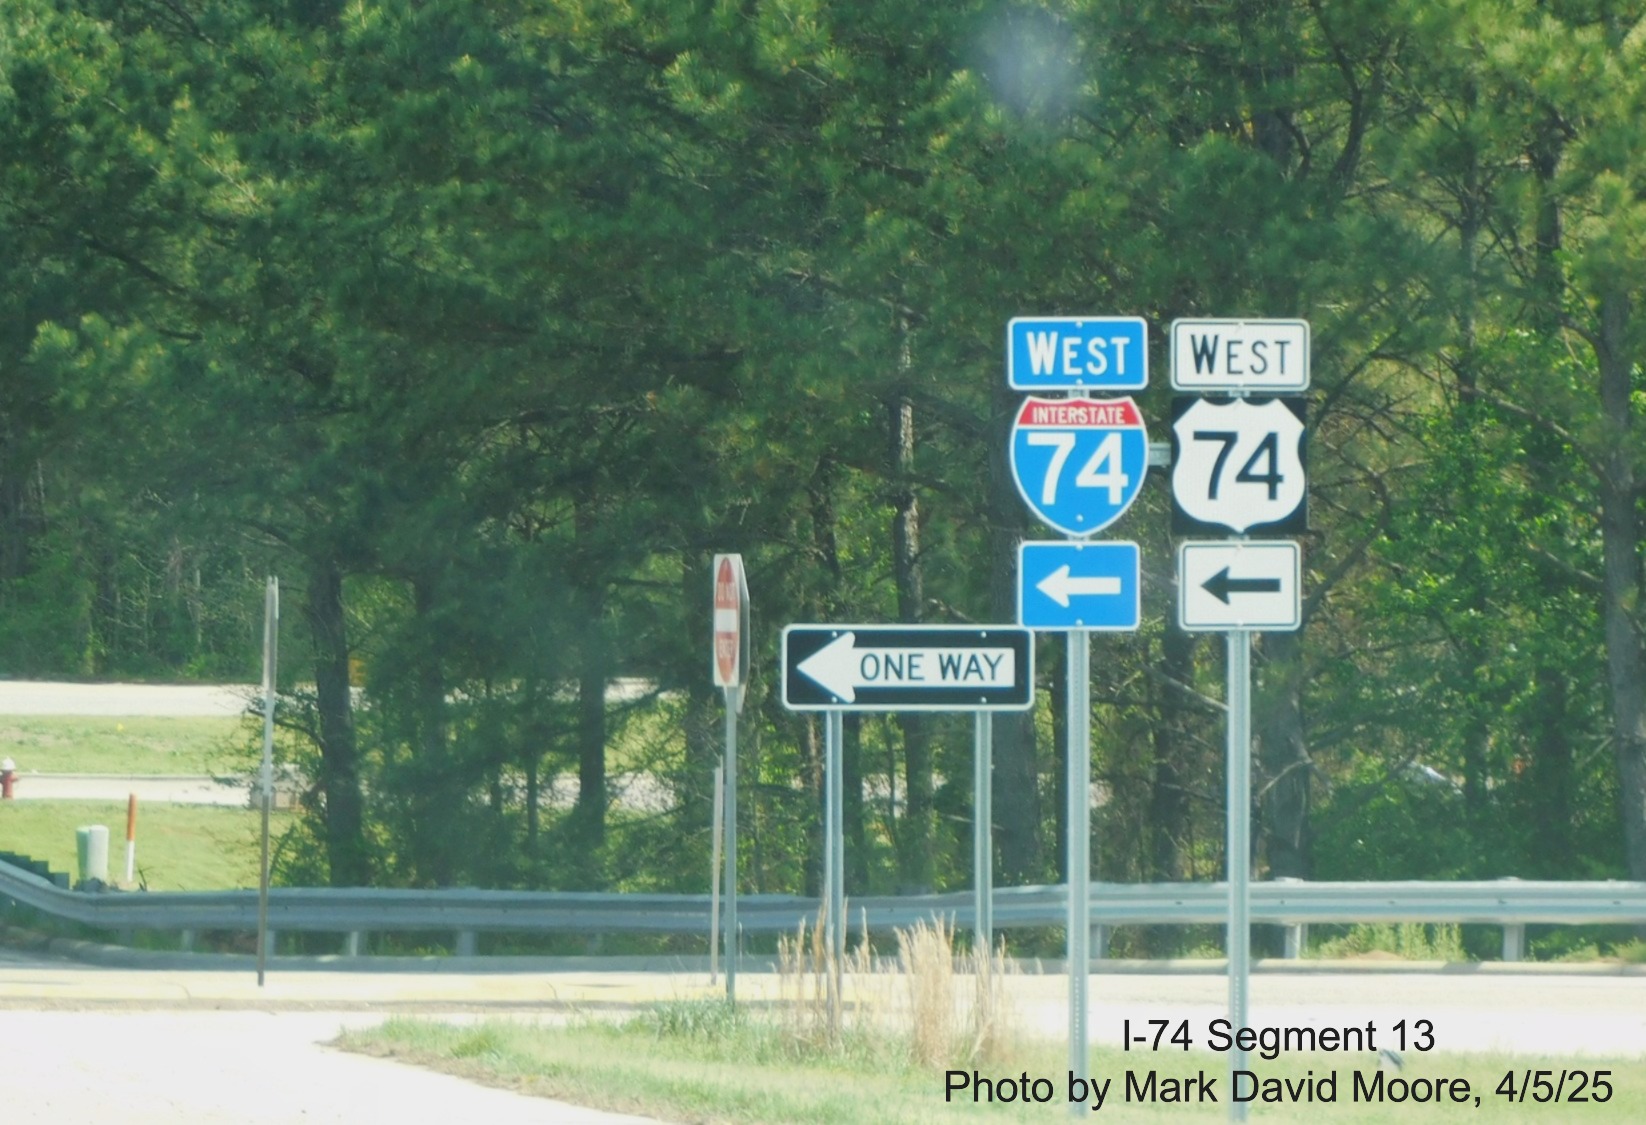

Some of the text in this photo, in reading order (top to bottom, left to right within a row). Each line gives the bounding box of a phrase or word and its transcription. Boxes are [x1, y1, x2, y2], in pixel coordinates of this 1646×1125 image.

[1026, 331, 1130, 376] WEST
[1190, 334, 1291, 375] WEST
[1032, 407, 1126, 425] INTERSTATE
[1027, 432, 1129, 505] 74
[1193, 431, 1284, 500] 74
[860, 653, 1004, 681] ONE WAY
